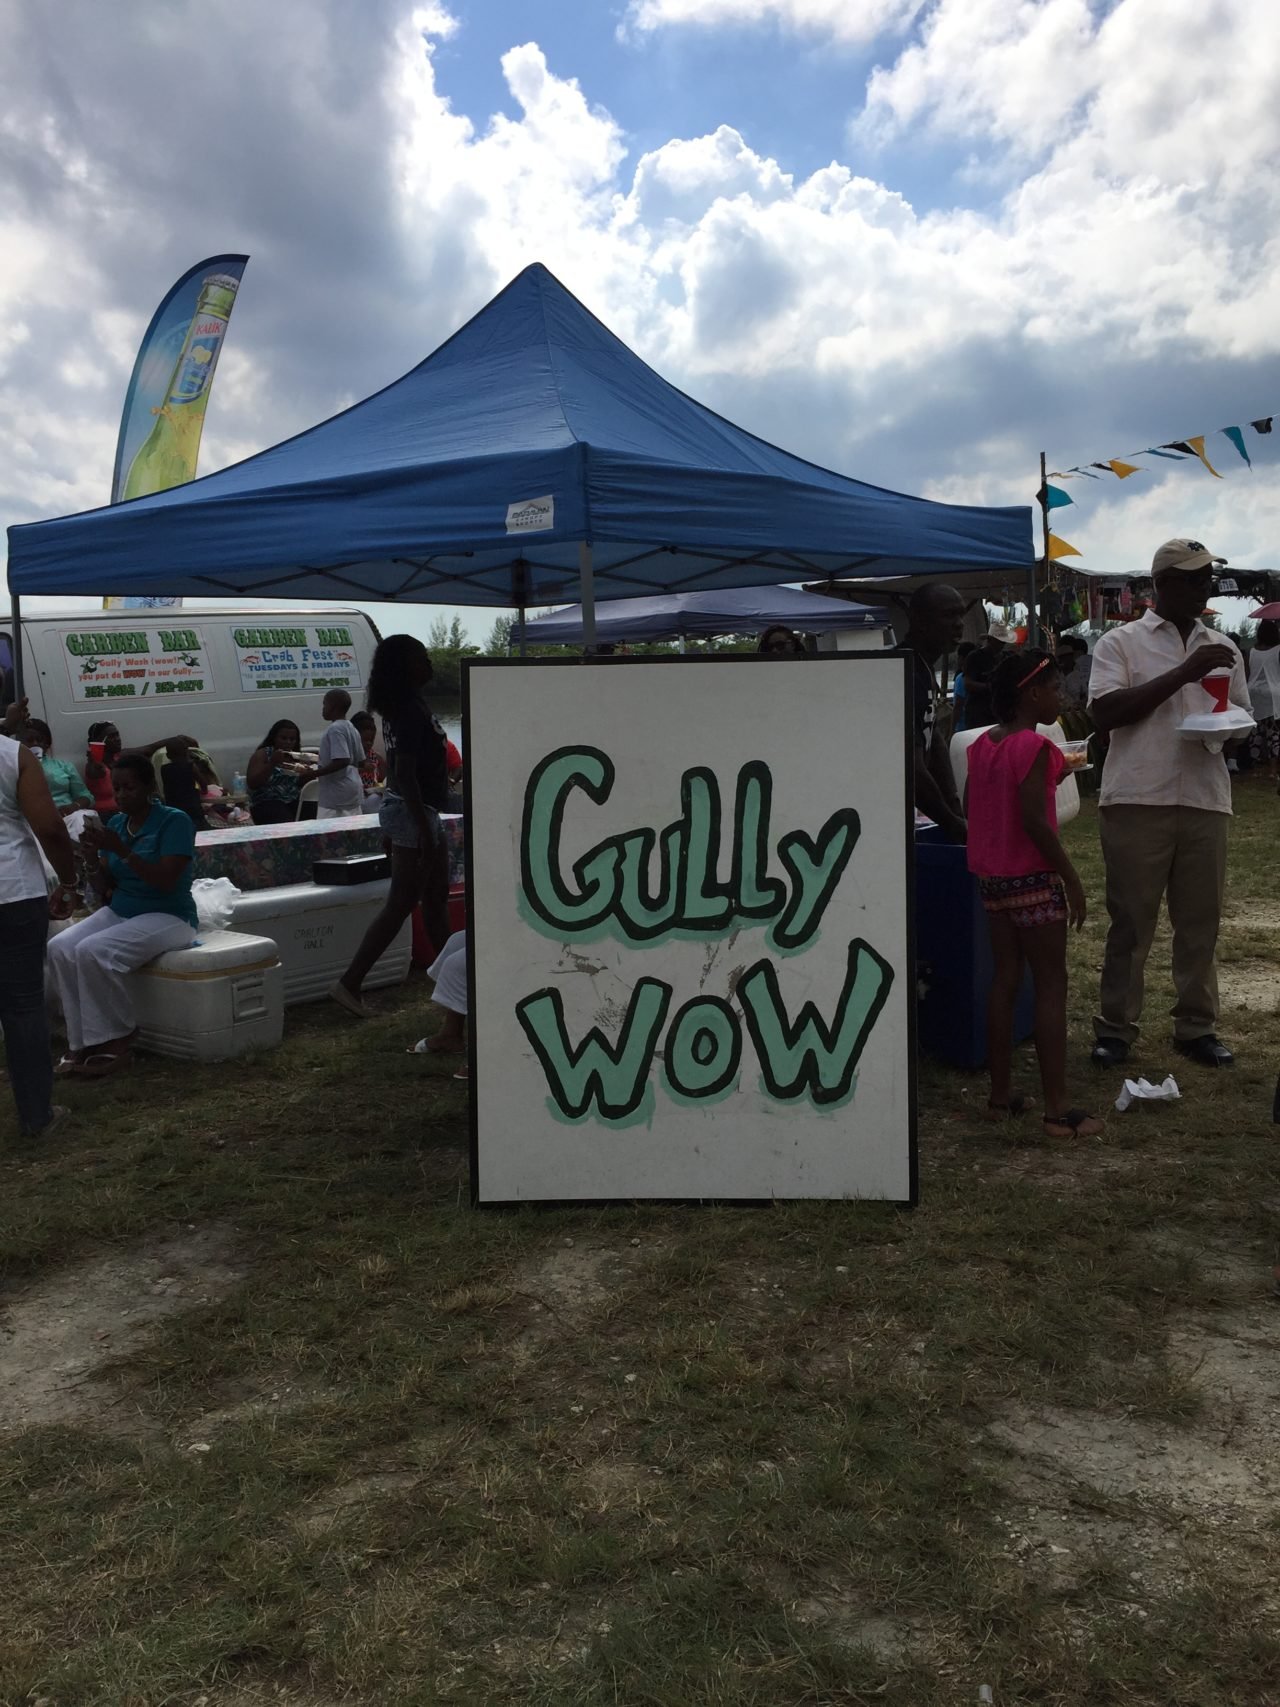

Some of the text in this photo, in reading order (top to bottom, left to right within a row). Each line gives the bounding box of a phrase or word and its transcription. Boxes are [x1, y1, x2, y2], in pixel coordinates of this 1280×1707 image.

[66, 630, 202, 656] GARDEN BAR
[234, 628, 354, 648] GARDEN BAR
[99, 658, 122, 669] Gully
[125, 657, 148, 666] Wash
[248, 663, 299, 672] TUESDAYS
[311, 660, 351, 669] FRIDAYS
[78, 673, 93, 682] you
[123, 669, 146, 679] WOW
[148, 669, 156, 677] in
[157, 668, 170, 677] our
[516, 937, 896, 1123] WOW
